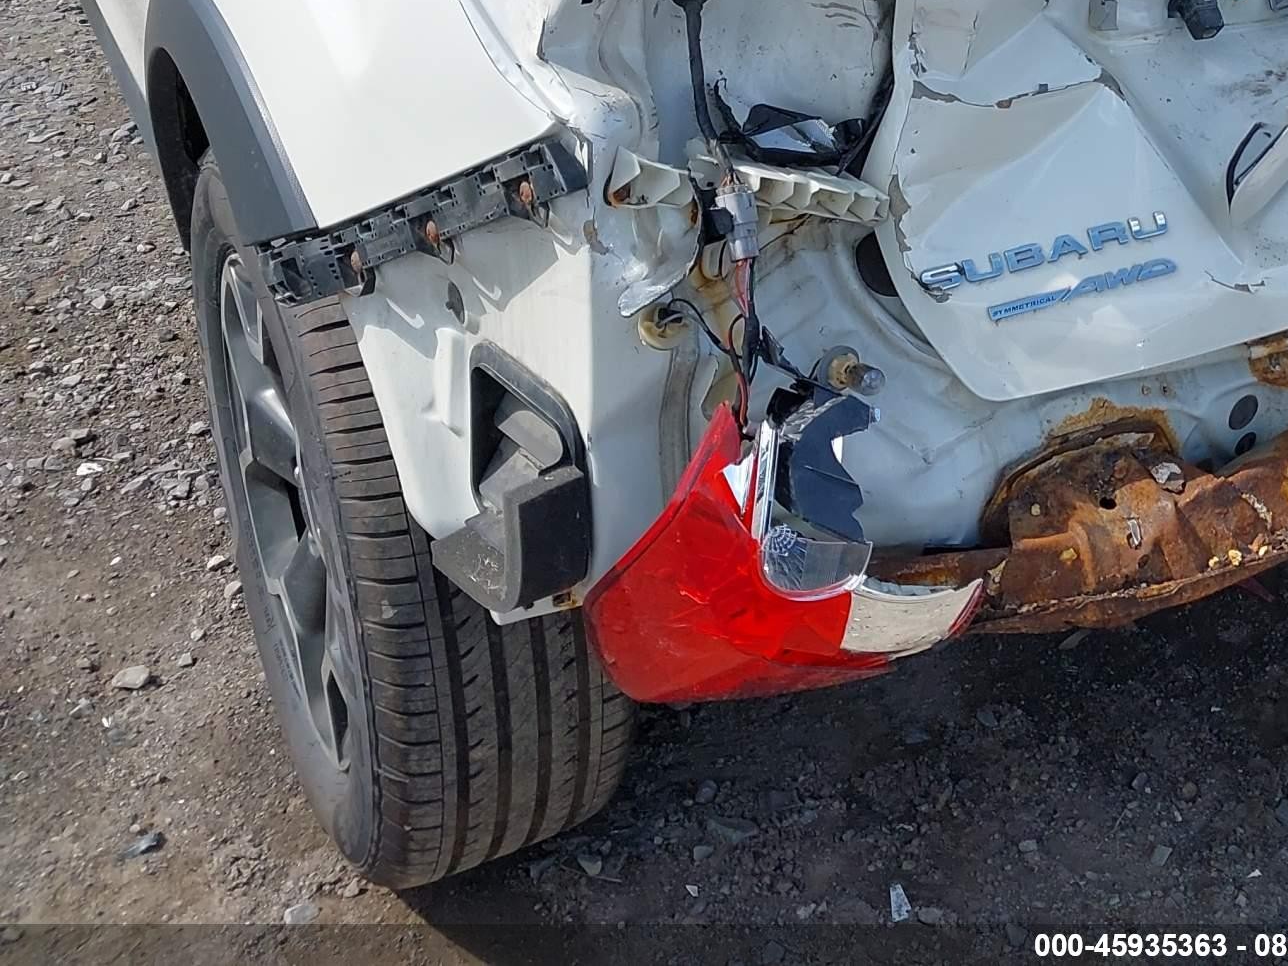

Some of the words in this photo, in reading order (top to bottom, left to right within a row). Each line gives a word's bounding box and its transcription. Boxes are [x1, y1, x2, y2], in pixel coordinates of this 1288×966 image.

[920, 211, 1169, 291] SUBARU
[992, 294, 1057, 318] SYMMETRICAL
[1066, 258, 1177, 300] AWD
